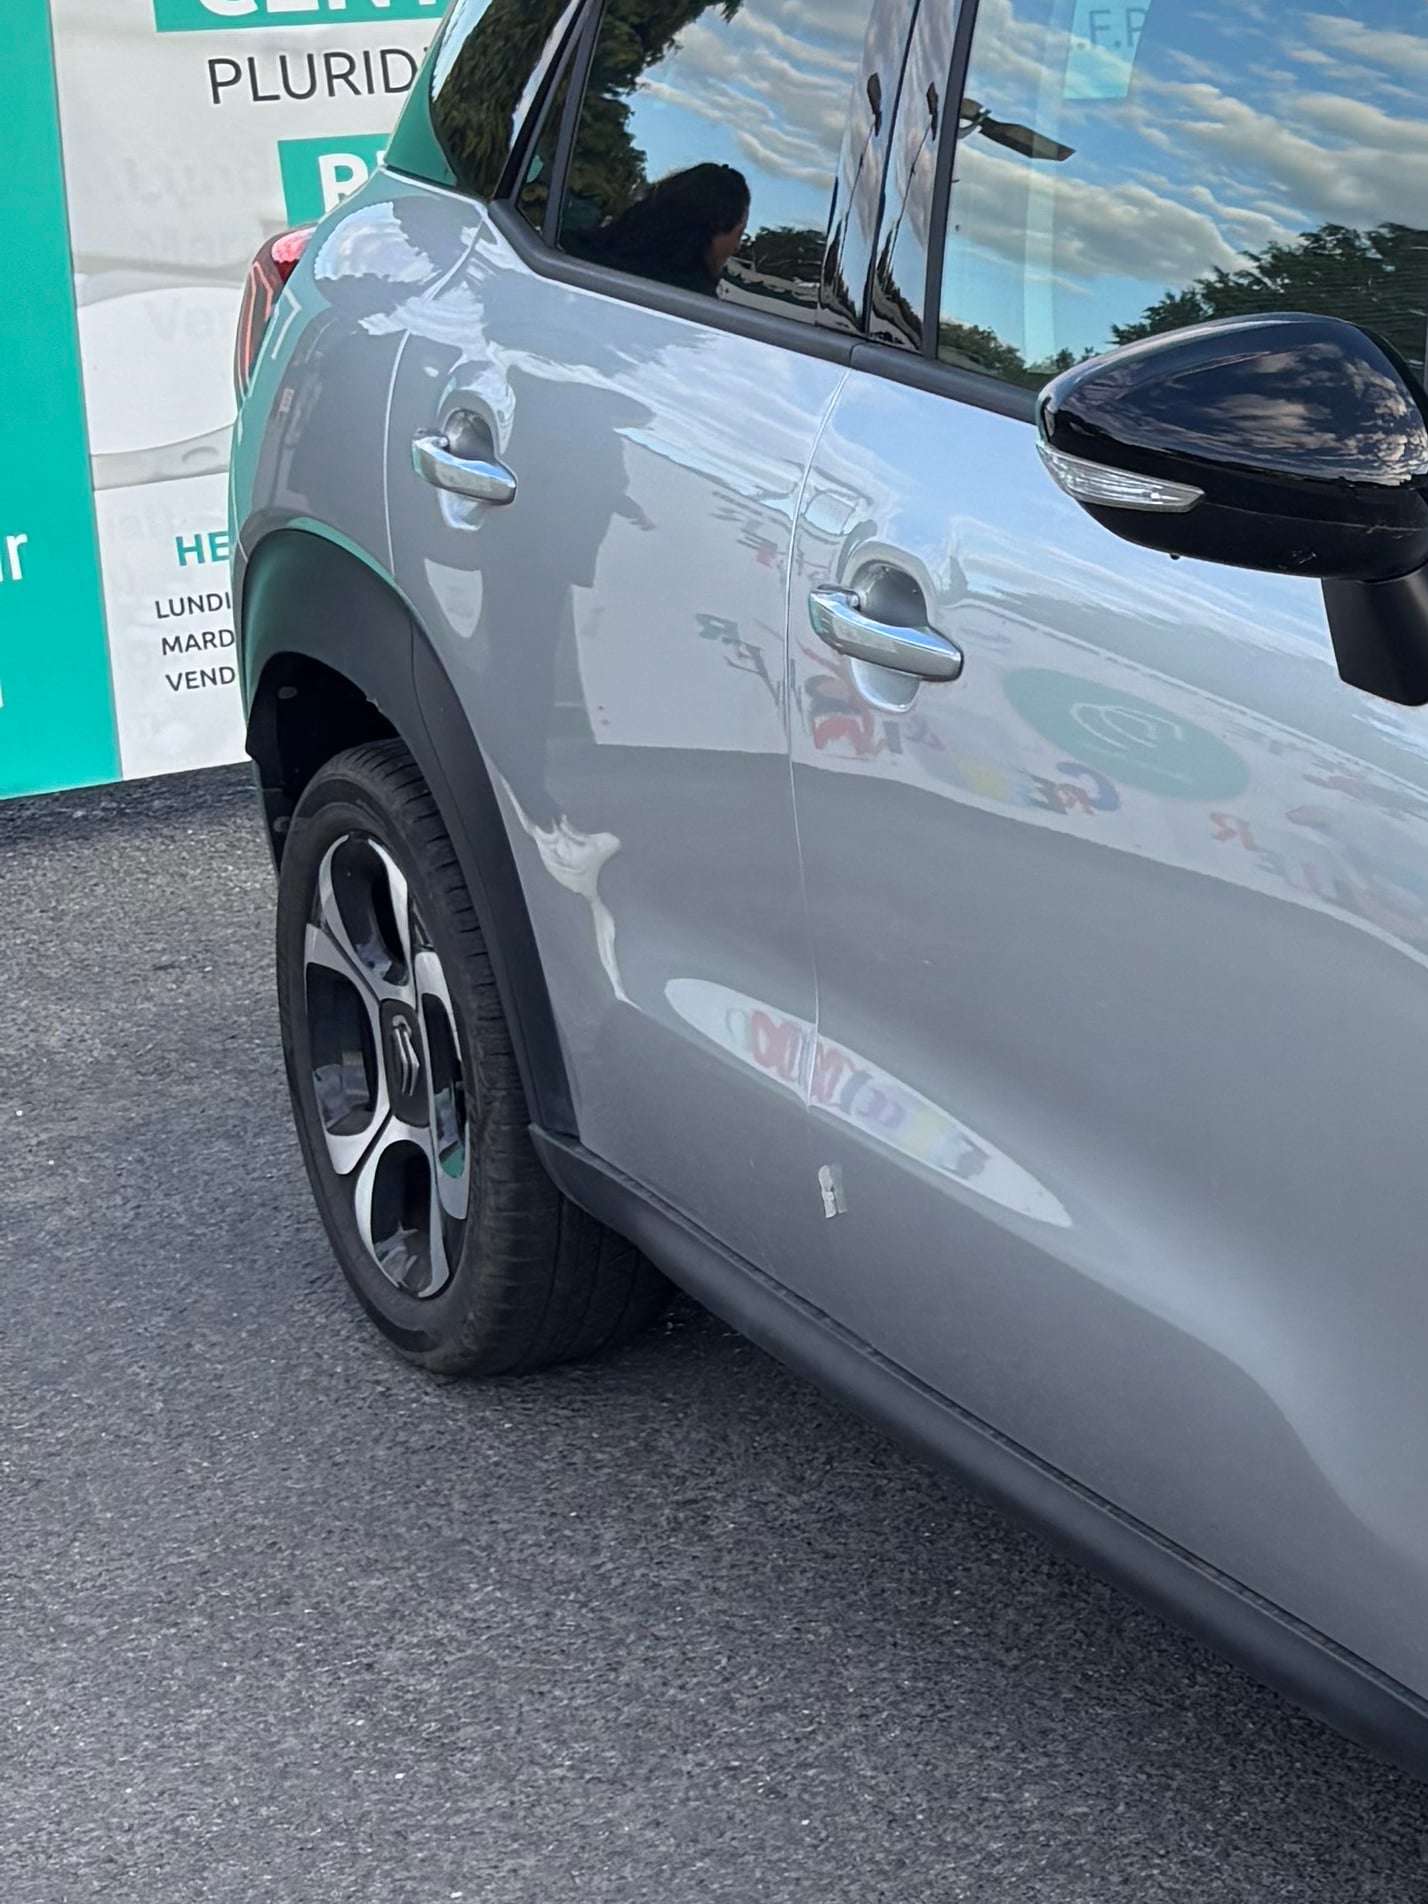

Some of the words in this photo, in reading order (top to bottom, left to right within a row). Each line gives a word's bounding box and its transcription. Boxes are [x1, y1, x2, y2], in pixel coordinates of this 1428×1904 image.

[207, 47, 430, 104] PLURID
[0, 533, 28, 582] r
[155, 591, 232, 619] LUNDI
[161, 629, 235, 656] MARD
[165, 666, 236, 692] VEND
